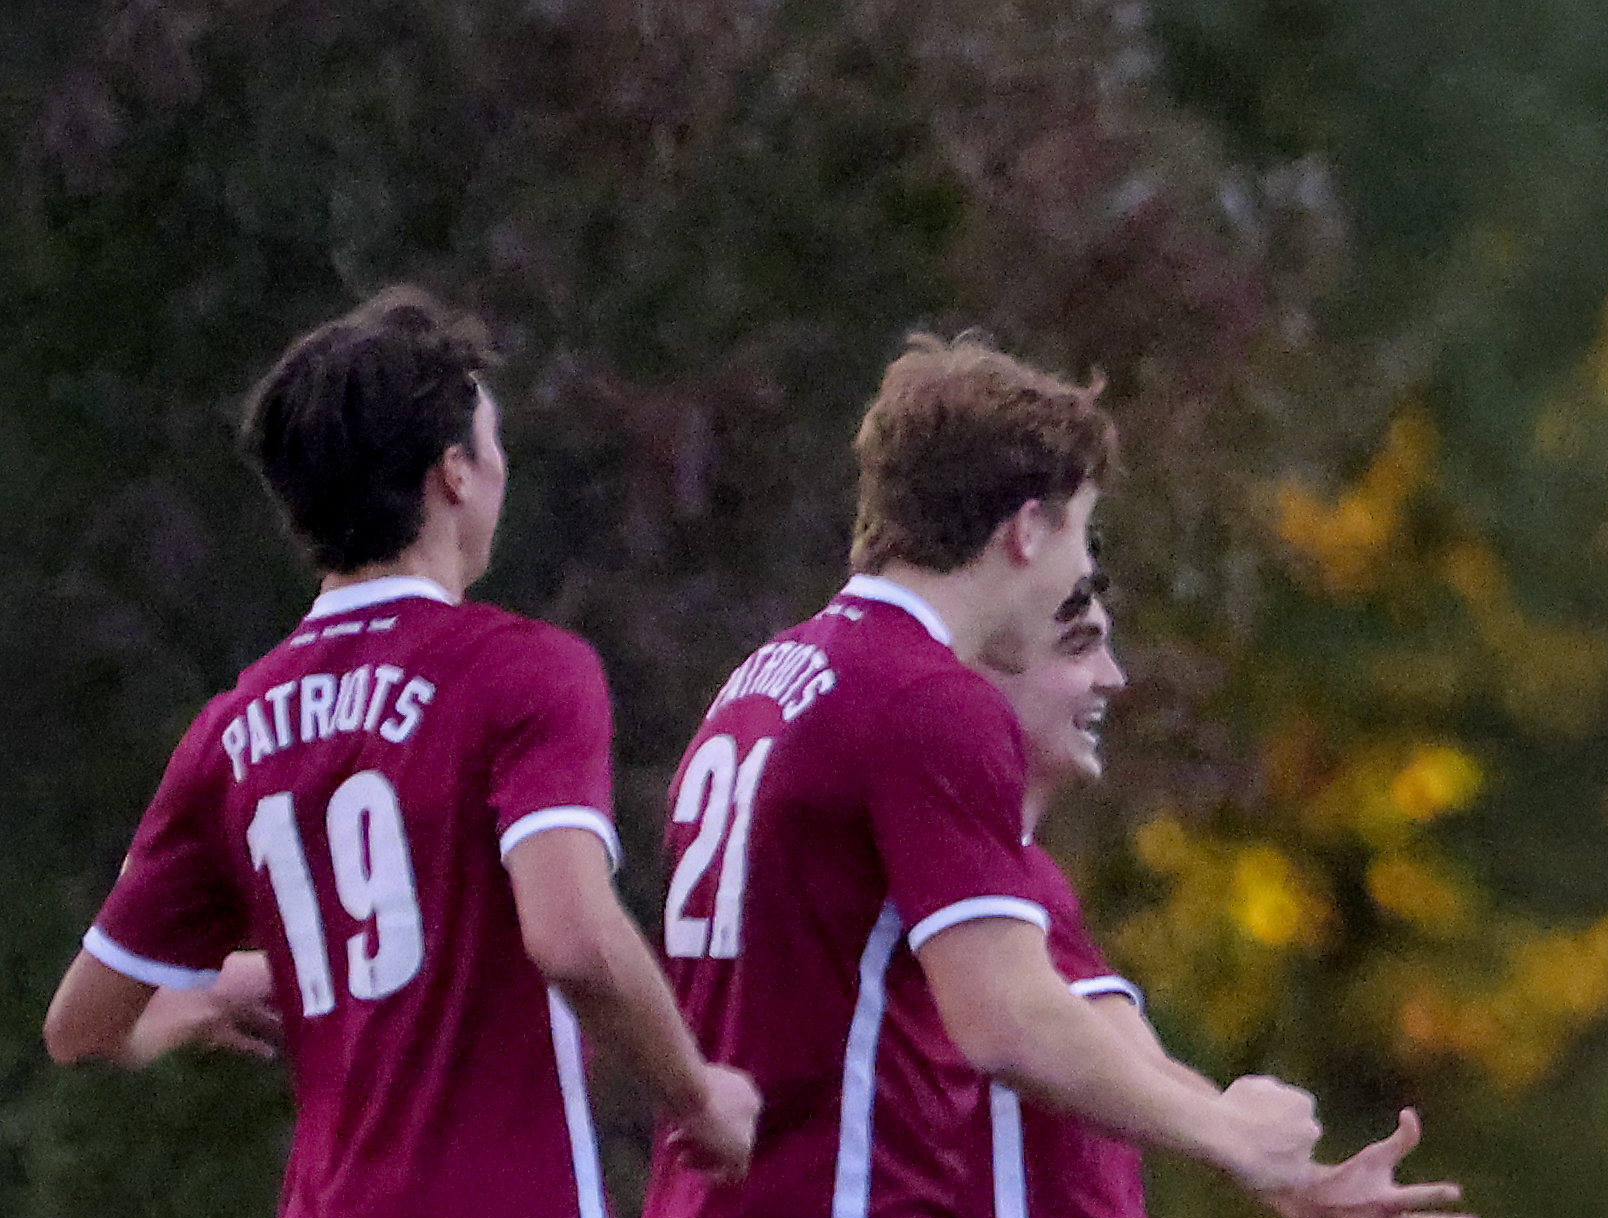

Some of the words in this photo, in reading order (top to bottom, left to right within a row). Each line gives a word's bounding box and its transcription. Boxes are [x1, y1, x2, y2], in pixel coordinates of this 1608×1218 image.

[221, 664, 436, 783] PATRIOTS
[246, 770, 425, 1018] 19
[664, 733, 774, 959] 21
